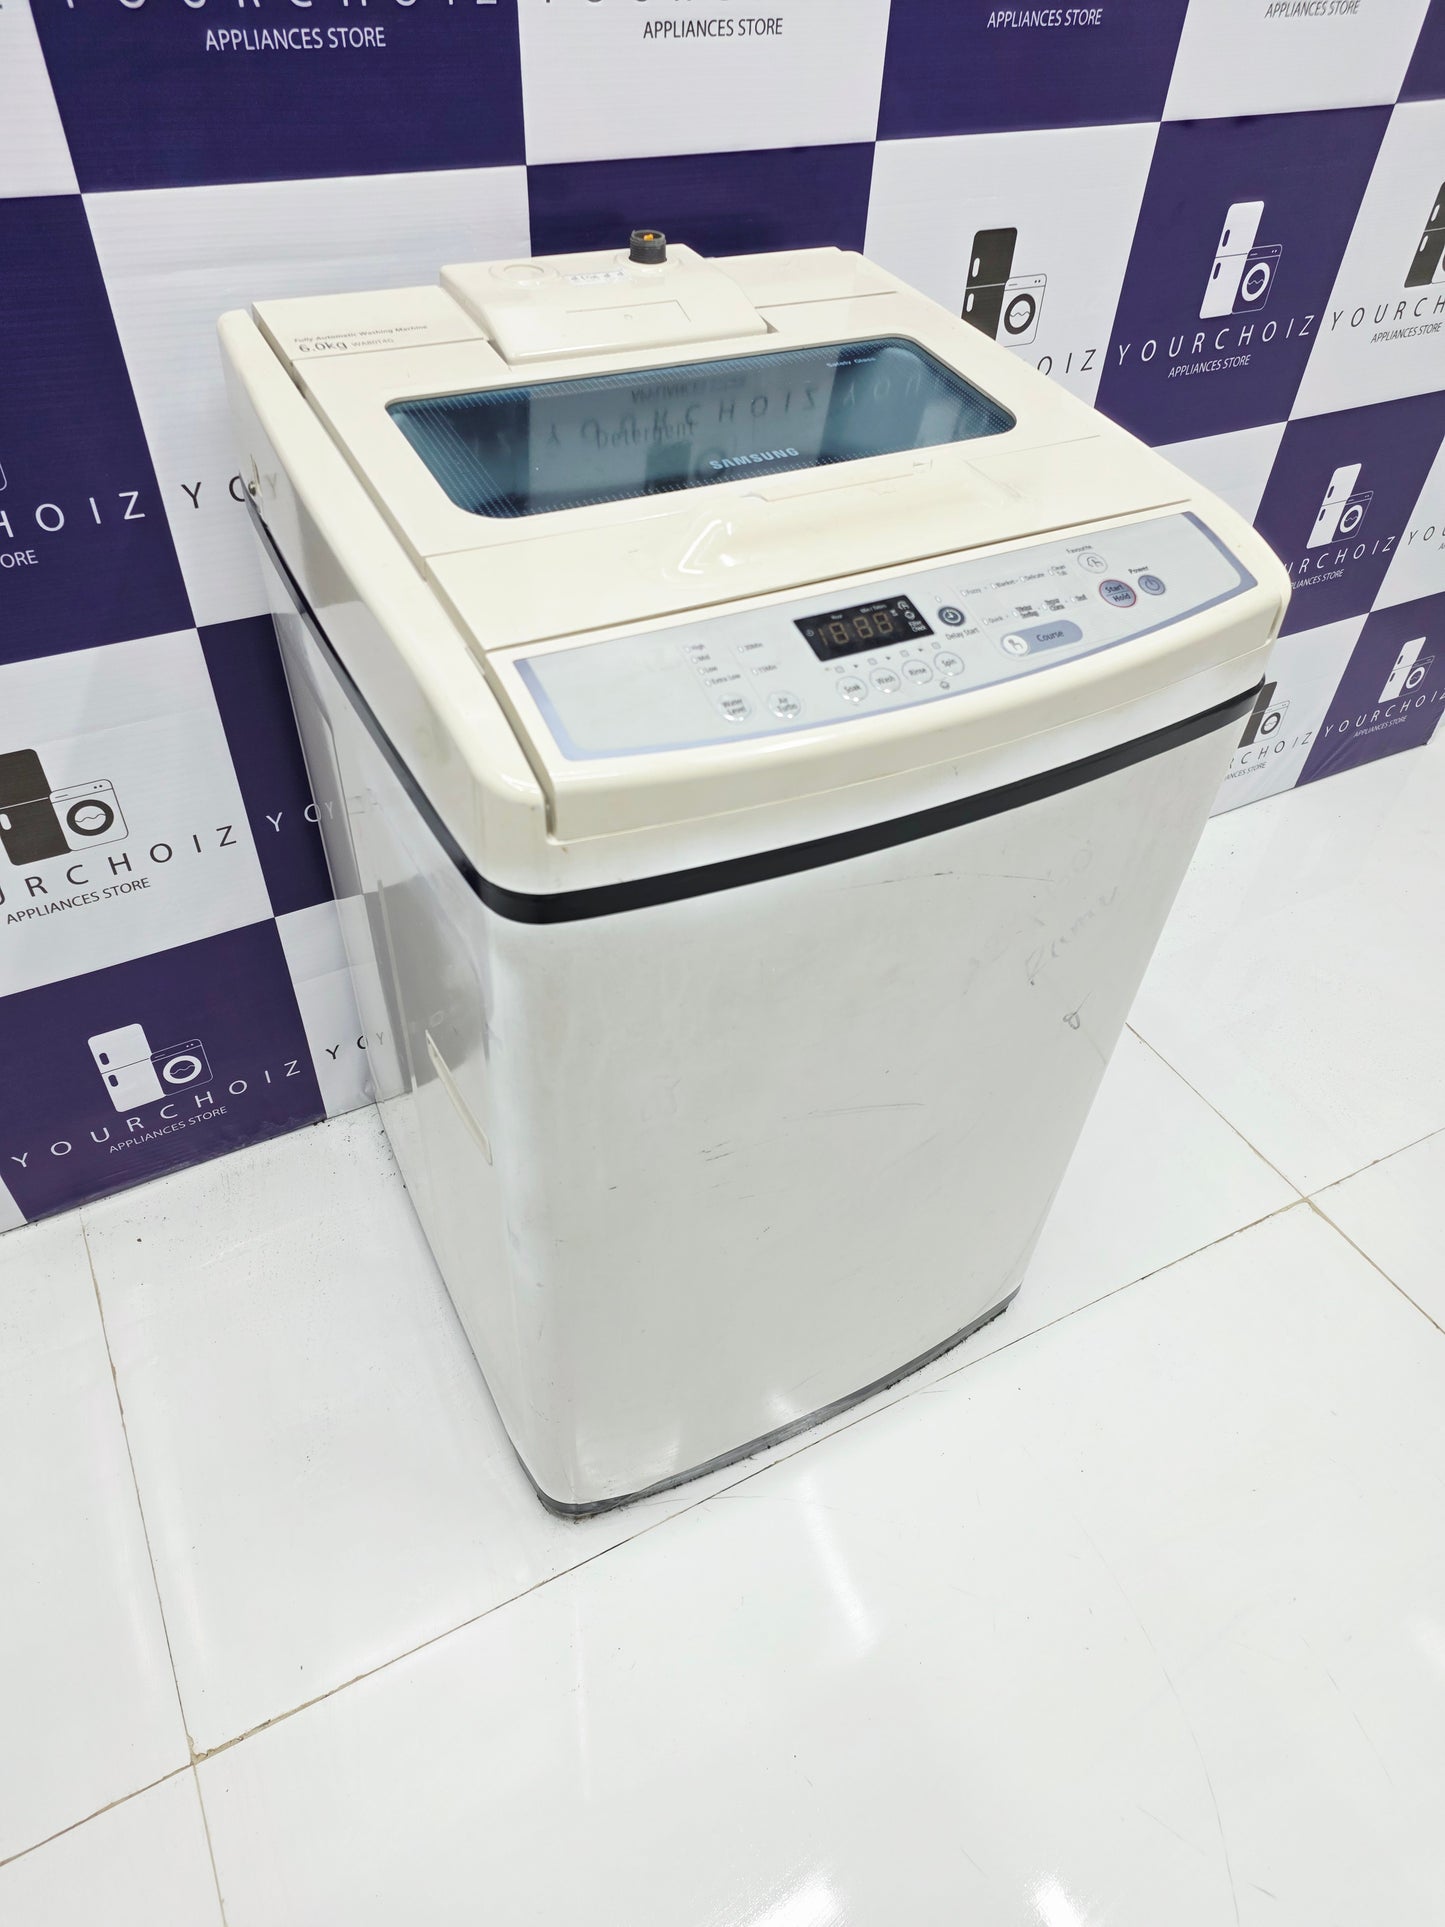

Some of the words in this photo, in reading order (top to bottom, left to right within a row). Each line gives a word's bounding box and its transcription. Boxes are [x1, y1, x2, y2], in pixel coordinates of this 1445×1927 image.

[987, 9, 1063, 28] APPLIANCES
[1064, 8, 1103, 26] STORE
[1264, 0, 1327, 18] APPLIANCES
[1327, 0, 1360, 16] STORE
[643, 19, 735, 39] APPLIANCES
[737, 18, 783, 36] STORE
[205, 28, 324, 52] APPLIANCES
[327, 26, 387, 49] STORE
[1118, 315, 1315, 366] YOURCHOIZ
[1370, 326, 1419, 344] APPLIANCES
[1417, 322, 1443, 335] STORE
[298, 340, 349, 353] 6.0kg
[1167, 356, 1222, 379] APPLIANCES
[1222, 354, 1252, 370] STORE
[709, 447, 799, 470] SAMSUNG
[1127, 565, 1149, 574] Power
[1321, 569, 1344, 582] STORE
[1104, 584, 1125, 594] Start
[1112, 592, 1132, 602] Hold
[945, 630, 964, 642] Delay
[963, 626, 981, 637] Start
[1036, 629, 1064, 643] Course
[908, 668, 926, 676] Rinse
[941, 658, 957, 668] Spin
[876, 675, 896, 685] Wash
[6, 891, 100, 924] APPLIANCES
[102, 877, 151, 899] STORE
[11, 1060, 300, 1168] YOURCHOIZ
[109, 1120, 187, 1153] APPLIANCES
[187, 1105, 228, 1126] STORE
